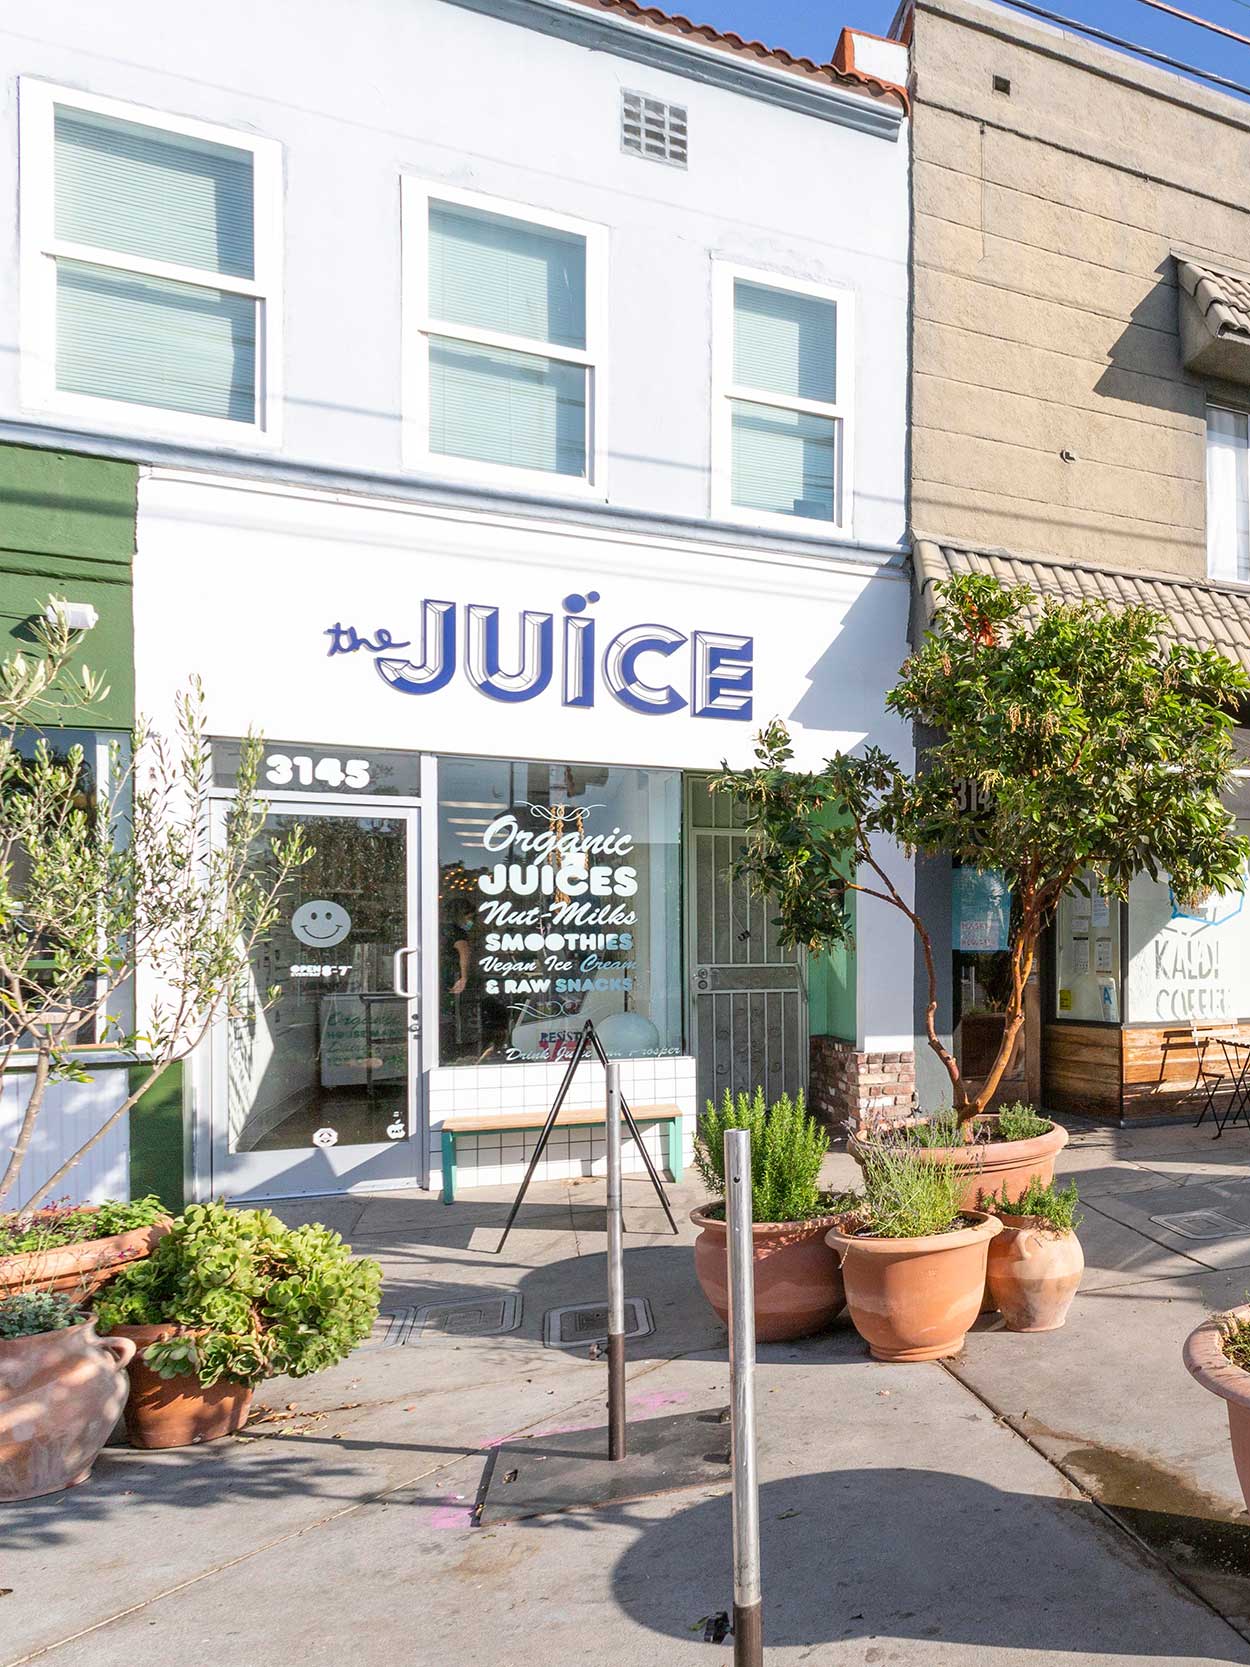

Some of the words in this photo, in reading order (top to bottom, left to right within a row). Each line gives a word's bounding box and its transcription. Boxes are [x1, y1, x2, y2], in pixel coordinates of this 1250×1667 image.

[323, 621, 411, 657] the
[266, 754, 370, 789] 3145
[483, 814, 635, 866] Organic
[478, 863, 639, 898] JUICES
[478, 900, 639, 927] Nut-Milks
[485, 932, 634, 952] SMOOTHIES
[478, 956, 537, 977] Vegan
[543, 956, 573, 972] Ice
[579, 954, 639, 973] Cream
[1154, 939, 1220, 980] KALDI
[485, 979, 500, 994] &
[504, 979, 552, 994] RAW
[554, 978, 634, 993] SNACKS
[505, 1047, 551, 1062] Drink
[554, 1046, 592, 1063] Juce
